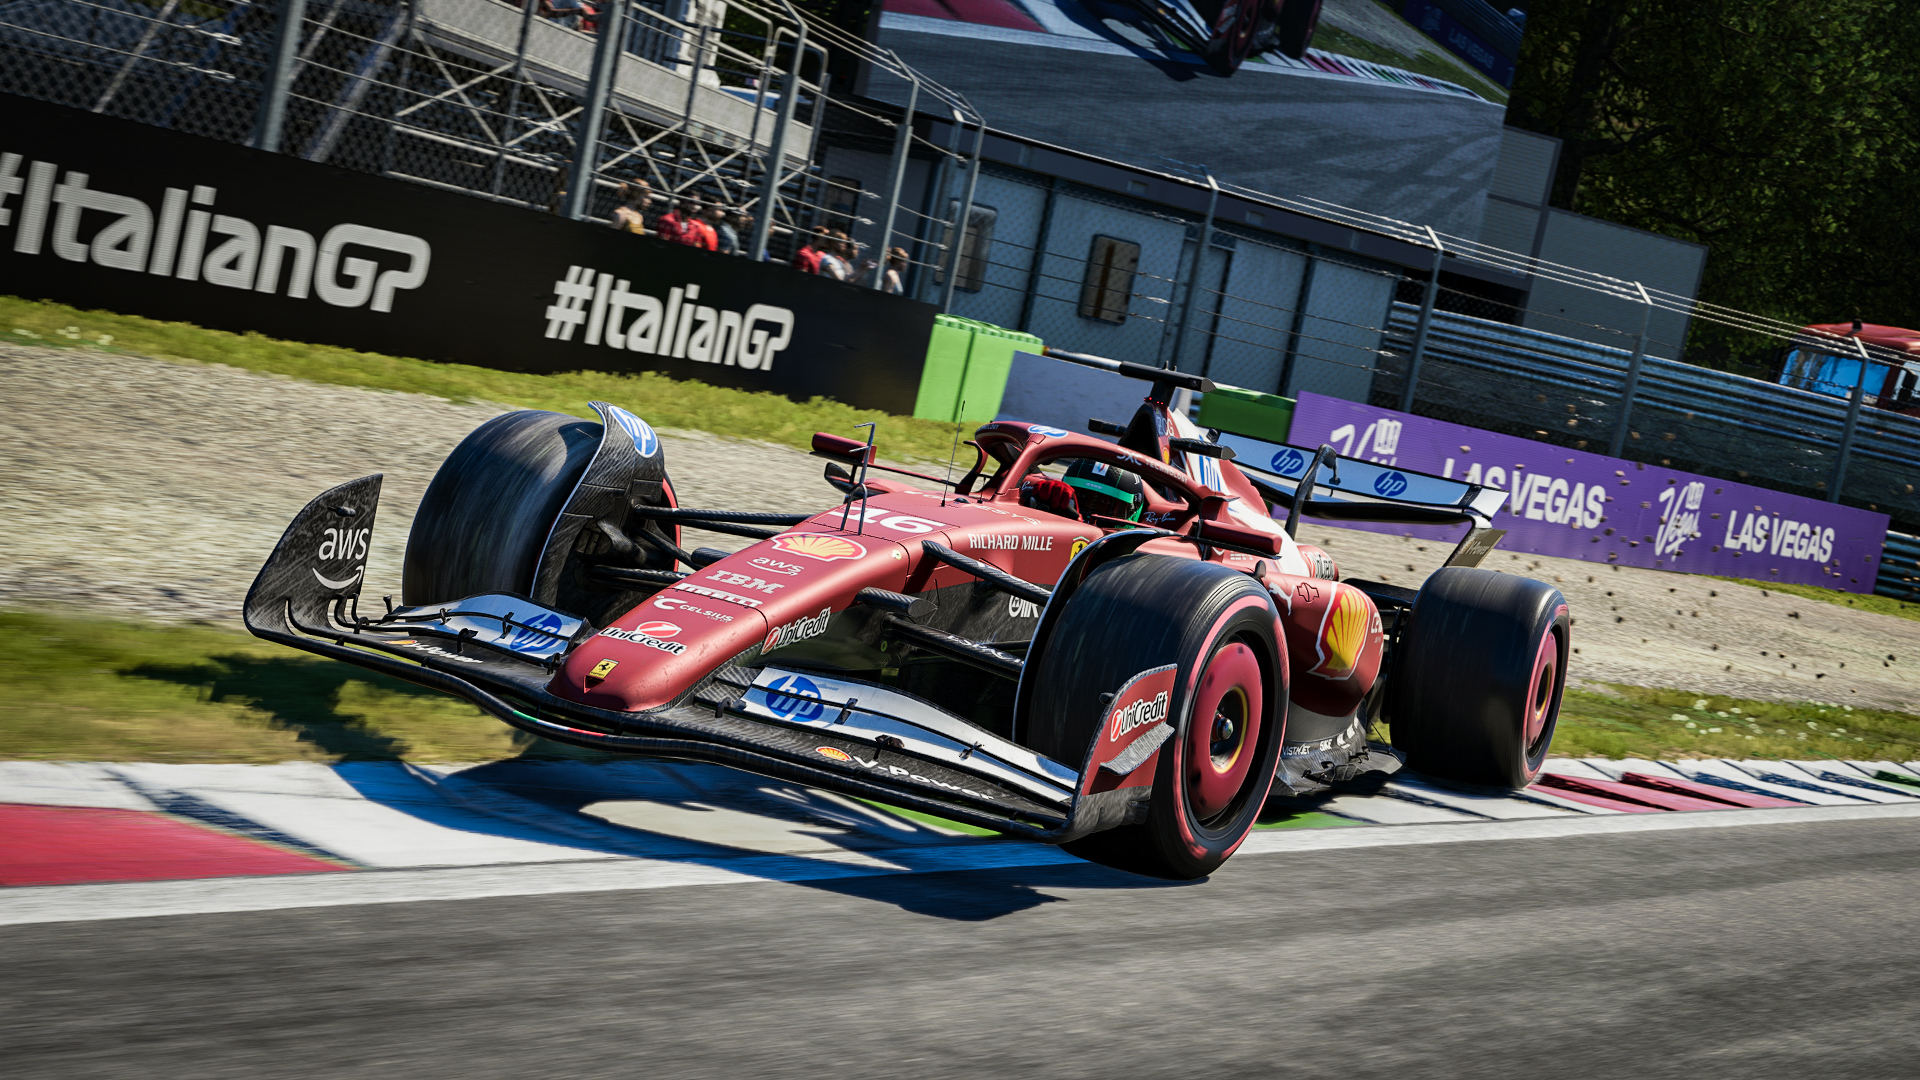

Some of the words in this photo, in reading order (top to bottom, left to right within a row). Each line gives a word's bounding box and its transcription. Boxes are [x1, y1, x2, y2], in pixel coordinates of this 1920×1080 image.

[545, 265, 794, 371] #ItalianGP
[610, 406, 657, 457] hp
[1272, 449, 1303, 474] hp
[1375, 471, 1406, 496] hp
[1510, 470, 1606, 529] VEGAS
[318, 527, 370, 560] aws
[968, 533, 1018, 551] RICHARD
[1021, 535, 1053, 551] MILLE
[1723, 510, 1770, 553] LAS
[1770, 518, 1835, 563] VEGAS
[705, 569, 785, 594] IBM
[752, 556, 805, 574] aws
[679, 604, 734, 622] CELSIUS
[774, 607, 831, 649] UniCredit
[599, 627, 687, 655] UniCredit
[769, 675, 820, 721] hp
[1120, 691, 1168, 735] UniCredit
[853, 755, 994, 800] V-Power
